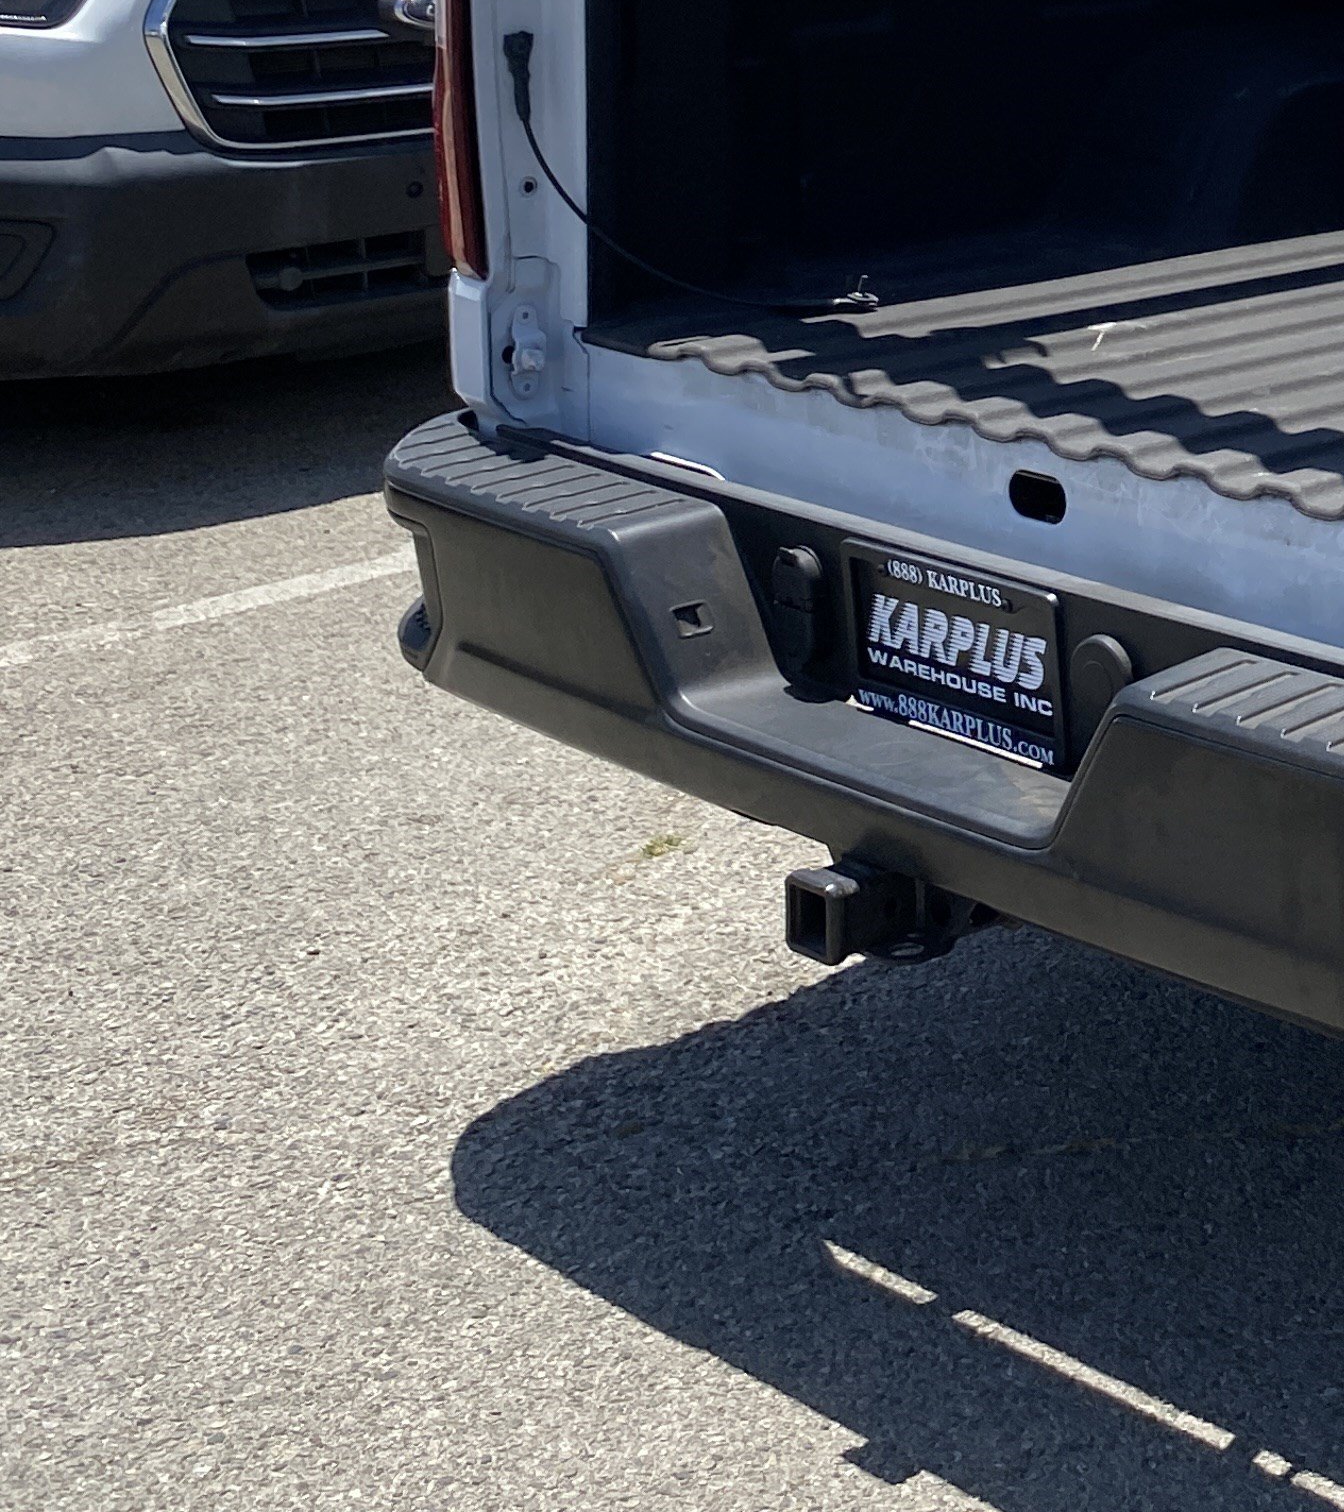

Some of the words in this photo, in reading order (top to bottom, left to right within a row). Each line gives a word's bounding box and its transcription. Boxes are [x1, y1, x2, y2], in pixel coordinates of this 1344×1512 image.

[886, 558, 924, 585] (888)
[926, 569, 1002, 608] KARPLUS
[867, 593, 1047, 691] KARPLUS
[867, 646, 1007, 704] WAREHOUSE
[1013, 691, 1054, 717] INC
